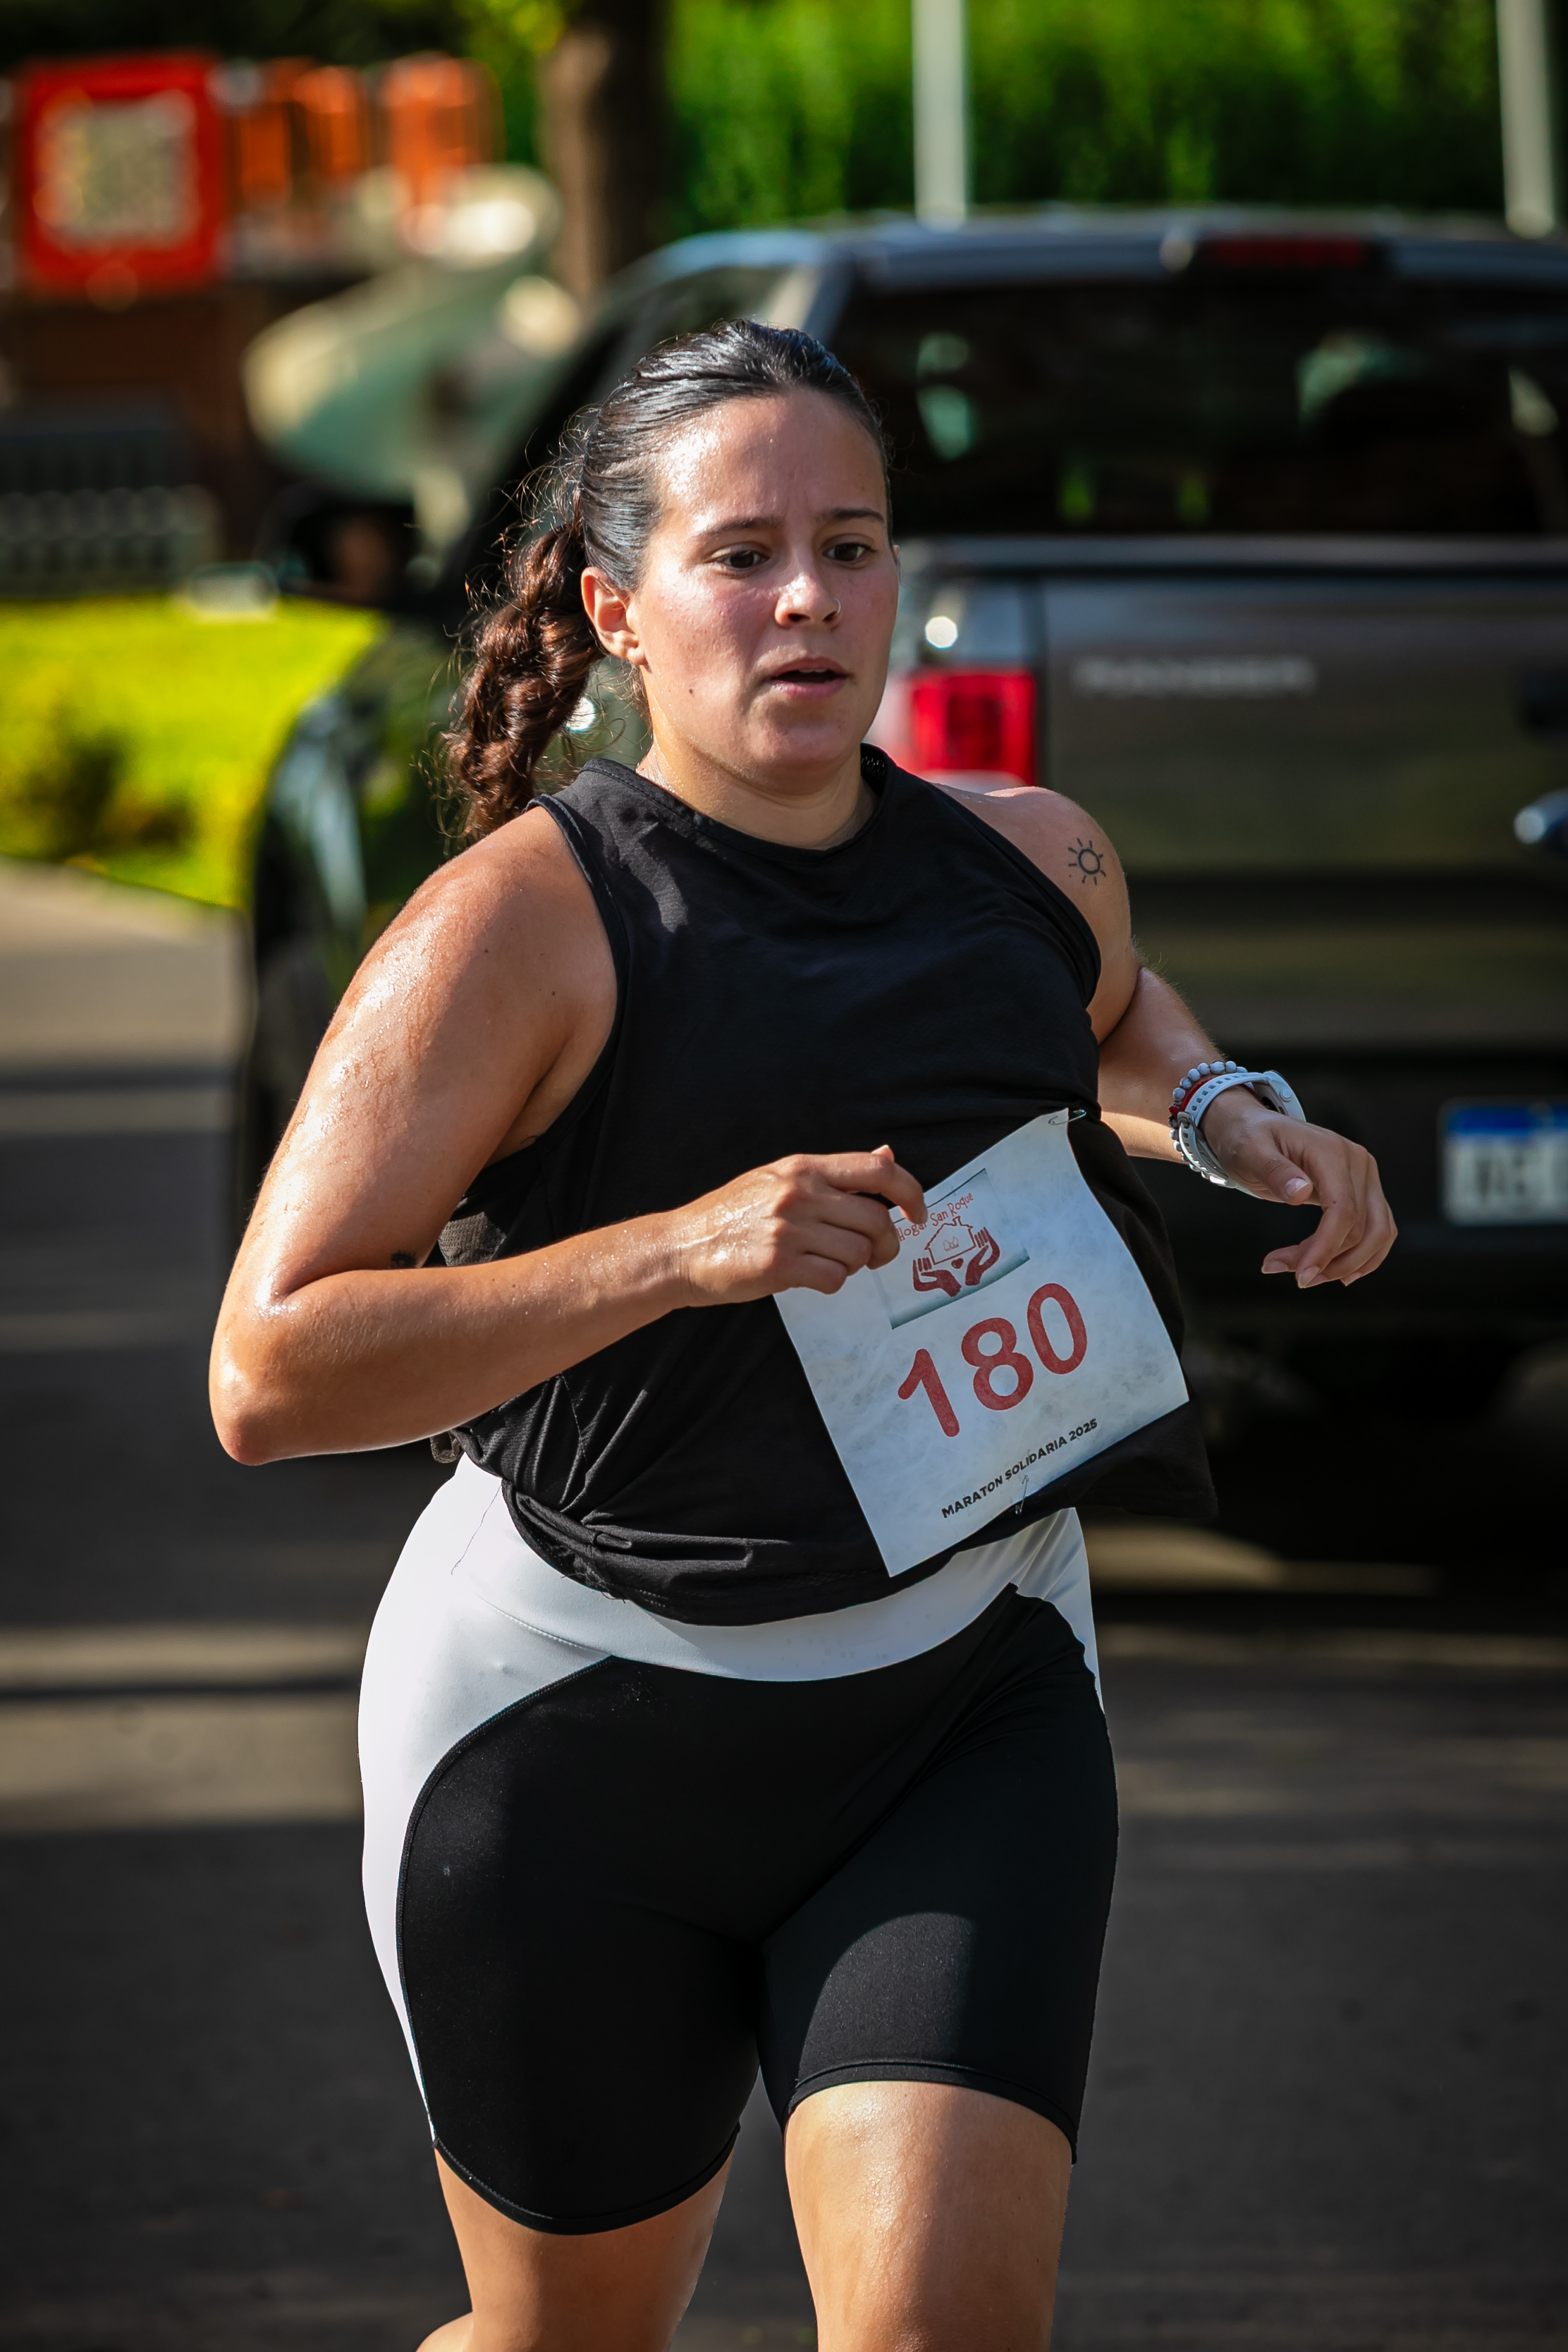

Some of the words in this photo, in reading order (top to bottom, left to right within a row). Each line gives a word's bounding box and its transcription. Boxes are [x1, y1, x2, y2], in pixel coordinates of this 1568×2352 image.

[929, 1211, 948, 1226] San
[947, 1193, 974, 1217] Roque
[898, 1282, 1087, 1438] 180
[941, 1476, 1003, 1518] MARATON
[1005, 1436, 1067, 1481] SOLIDARIA
[1068, 1418, 1098, 1441] 2025
